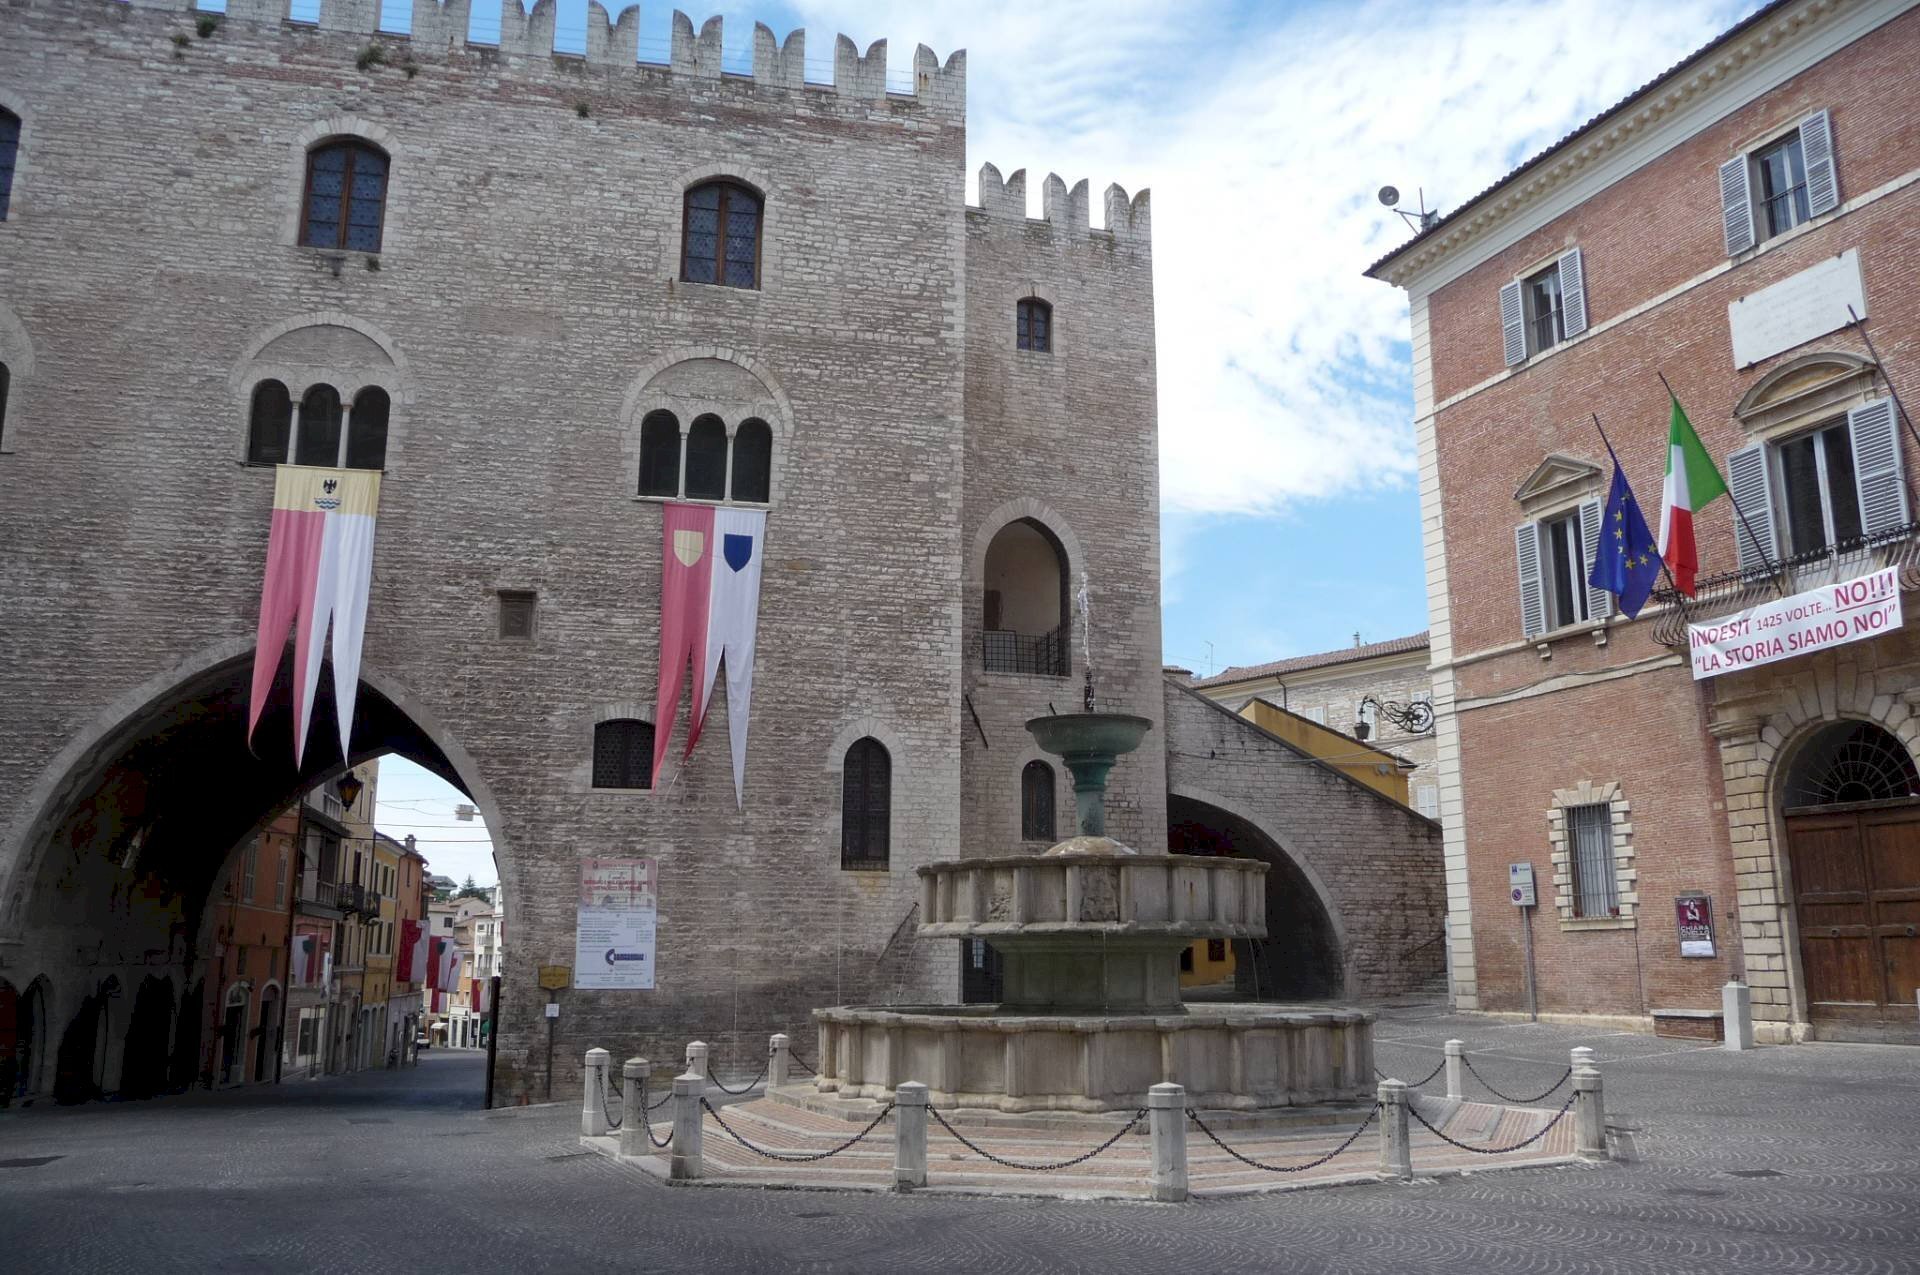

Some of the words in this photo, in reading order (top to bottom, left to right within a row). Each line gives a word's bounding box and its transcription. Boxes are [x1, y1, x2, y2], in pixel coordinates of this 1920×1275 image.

[1691, 618, 1751, 649] INDESIT
[1756, 613, 1782, 631] 1425
[1785, 602, 1832, 623] VOLTE...
[1834, 571, 1895, 607] NO!!!
[1694, 653, 1720, 672] “LA
[1725, 637, 1784, 667] STORIA
[1788, 619, 1848, 651] SIAMO
[1853, 603, 1896, 634] NOI”
